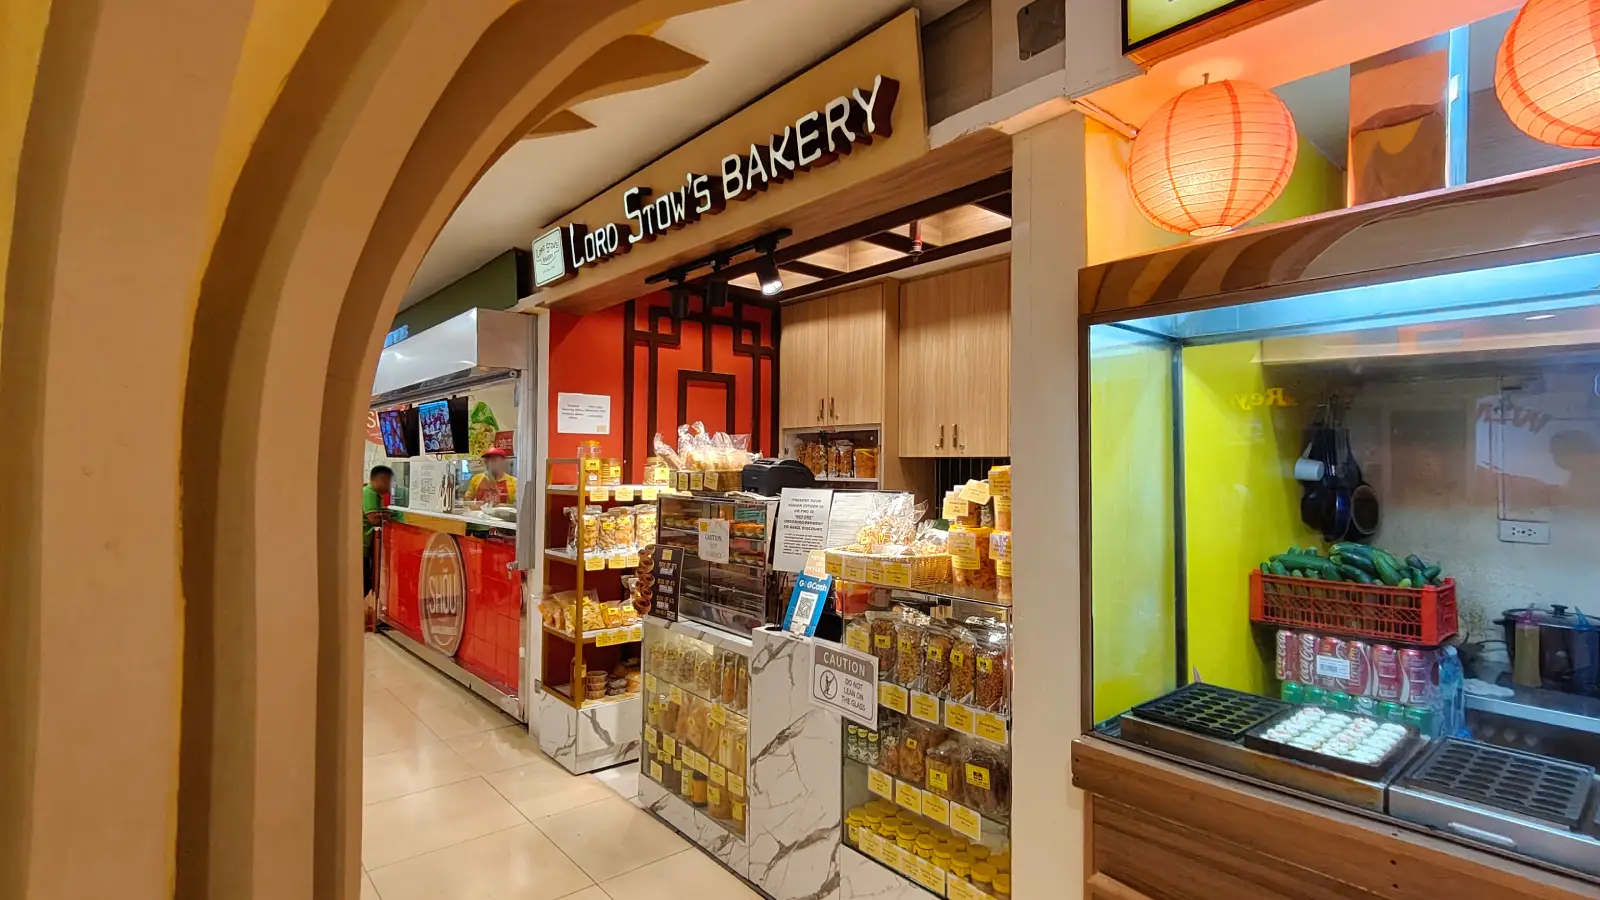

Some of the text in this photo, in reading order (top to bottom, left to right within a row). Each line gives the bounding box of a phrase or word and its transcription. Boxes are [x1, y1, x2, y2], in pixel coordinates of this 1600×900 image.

[569, 74, 882, 268] LORD STOW'S BAKERY
[806, 581, 827, 592] GCash
[823, 652, 866, 677] CAUTION
[845, 677, 864, 690] DO NOT
[843, 687, 864, 701] LEAN ON
[841, 695, 866, 712] THE GLASS
